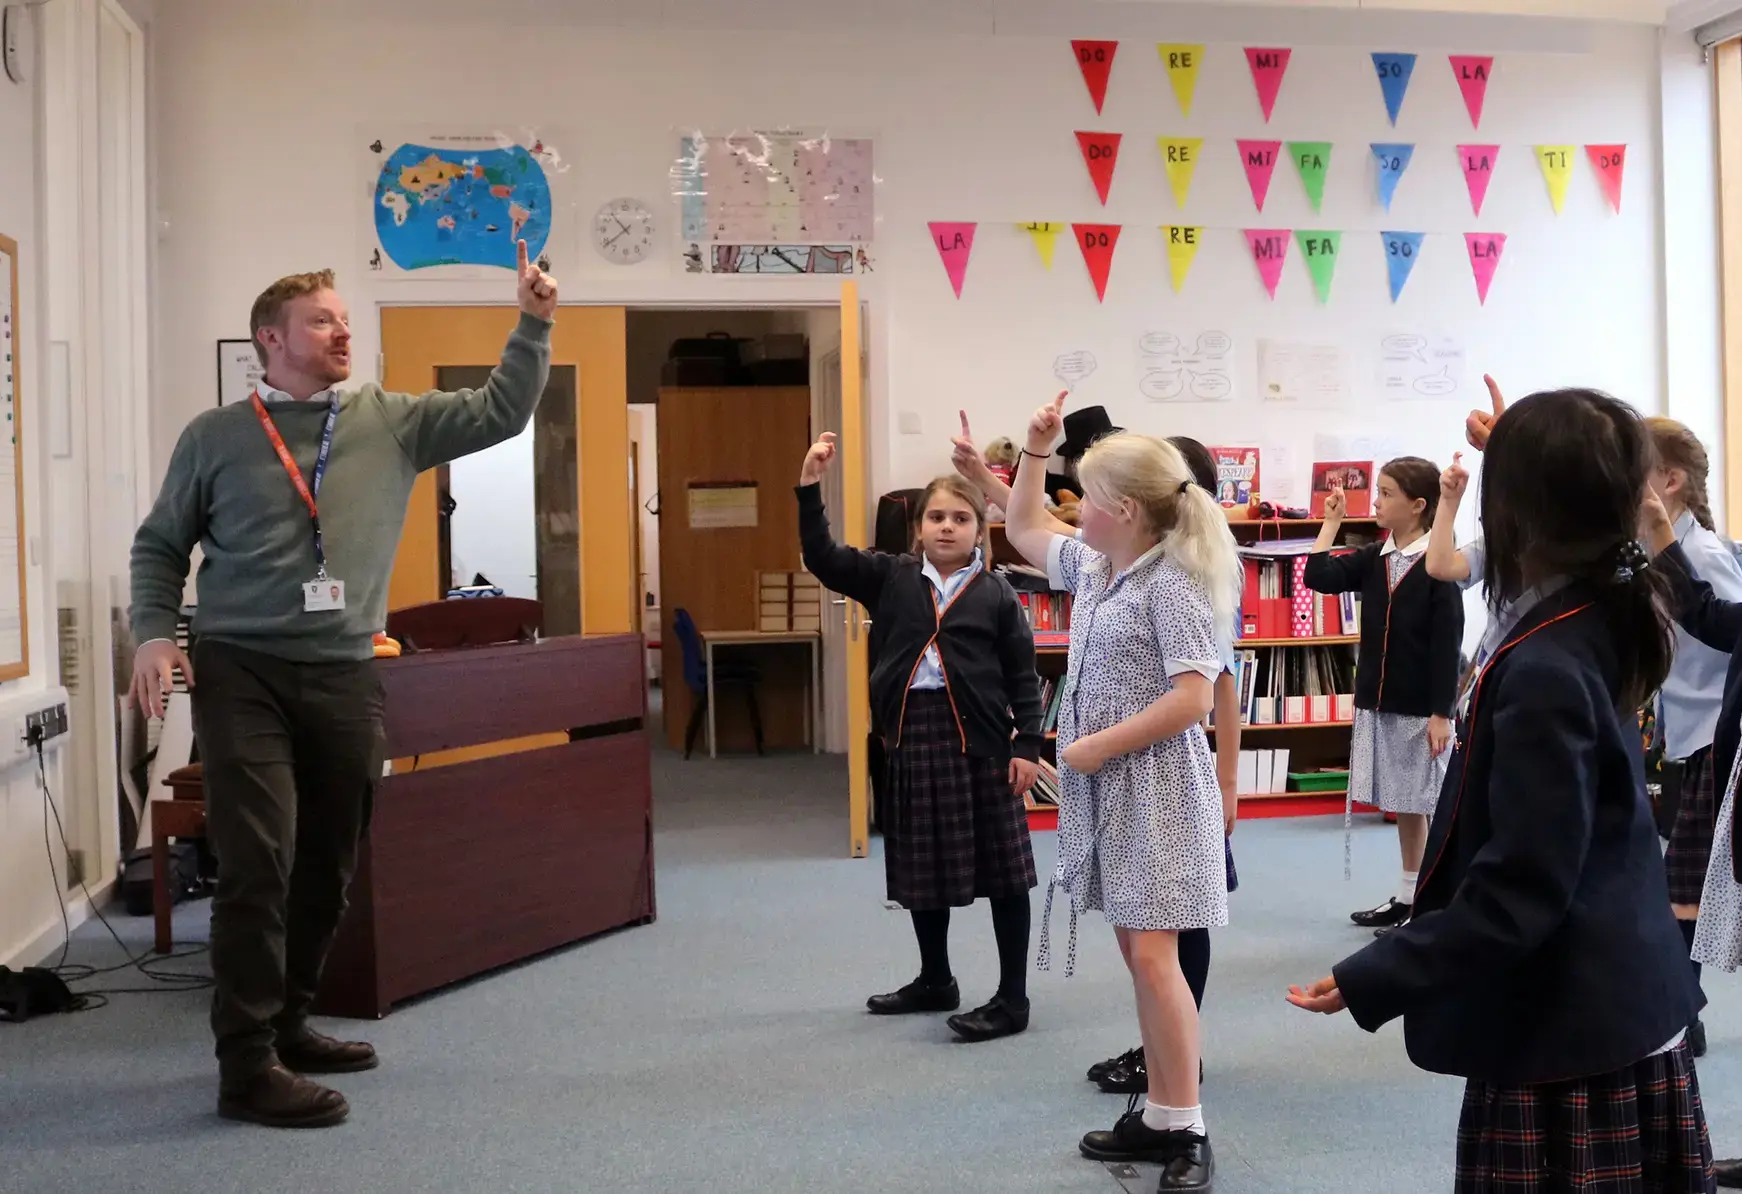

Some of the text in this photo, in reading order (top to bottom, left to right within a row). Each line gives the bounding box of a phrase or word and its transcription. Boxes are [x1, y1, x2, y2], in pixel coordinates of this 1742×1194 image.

[1080, 48, 1487, 80] DO RE MI SO LA
[1088, 144, 1621, 171] DO RE MI FA SO LA TI DO
[939, 232, 967, 251] LA
[1085, 232, 1109, 249] DO
[1170, 227, 1196, 244] RE
[1254, 237, 1285, 259] MI
[1306, 238, 1334, 257] FA
[1389, 241, 1413, 258] SO
[1473, 240, 1498, 258] LA
